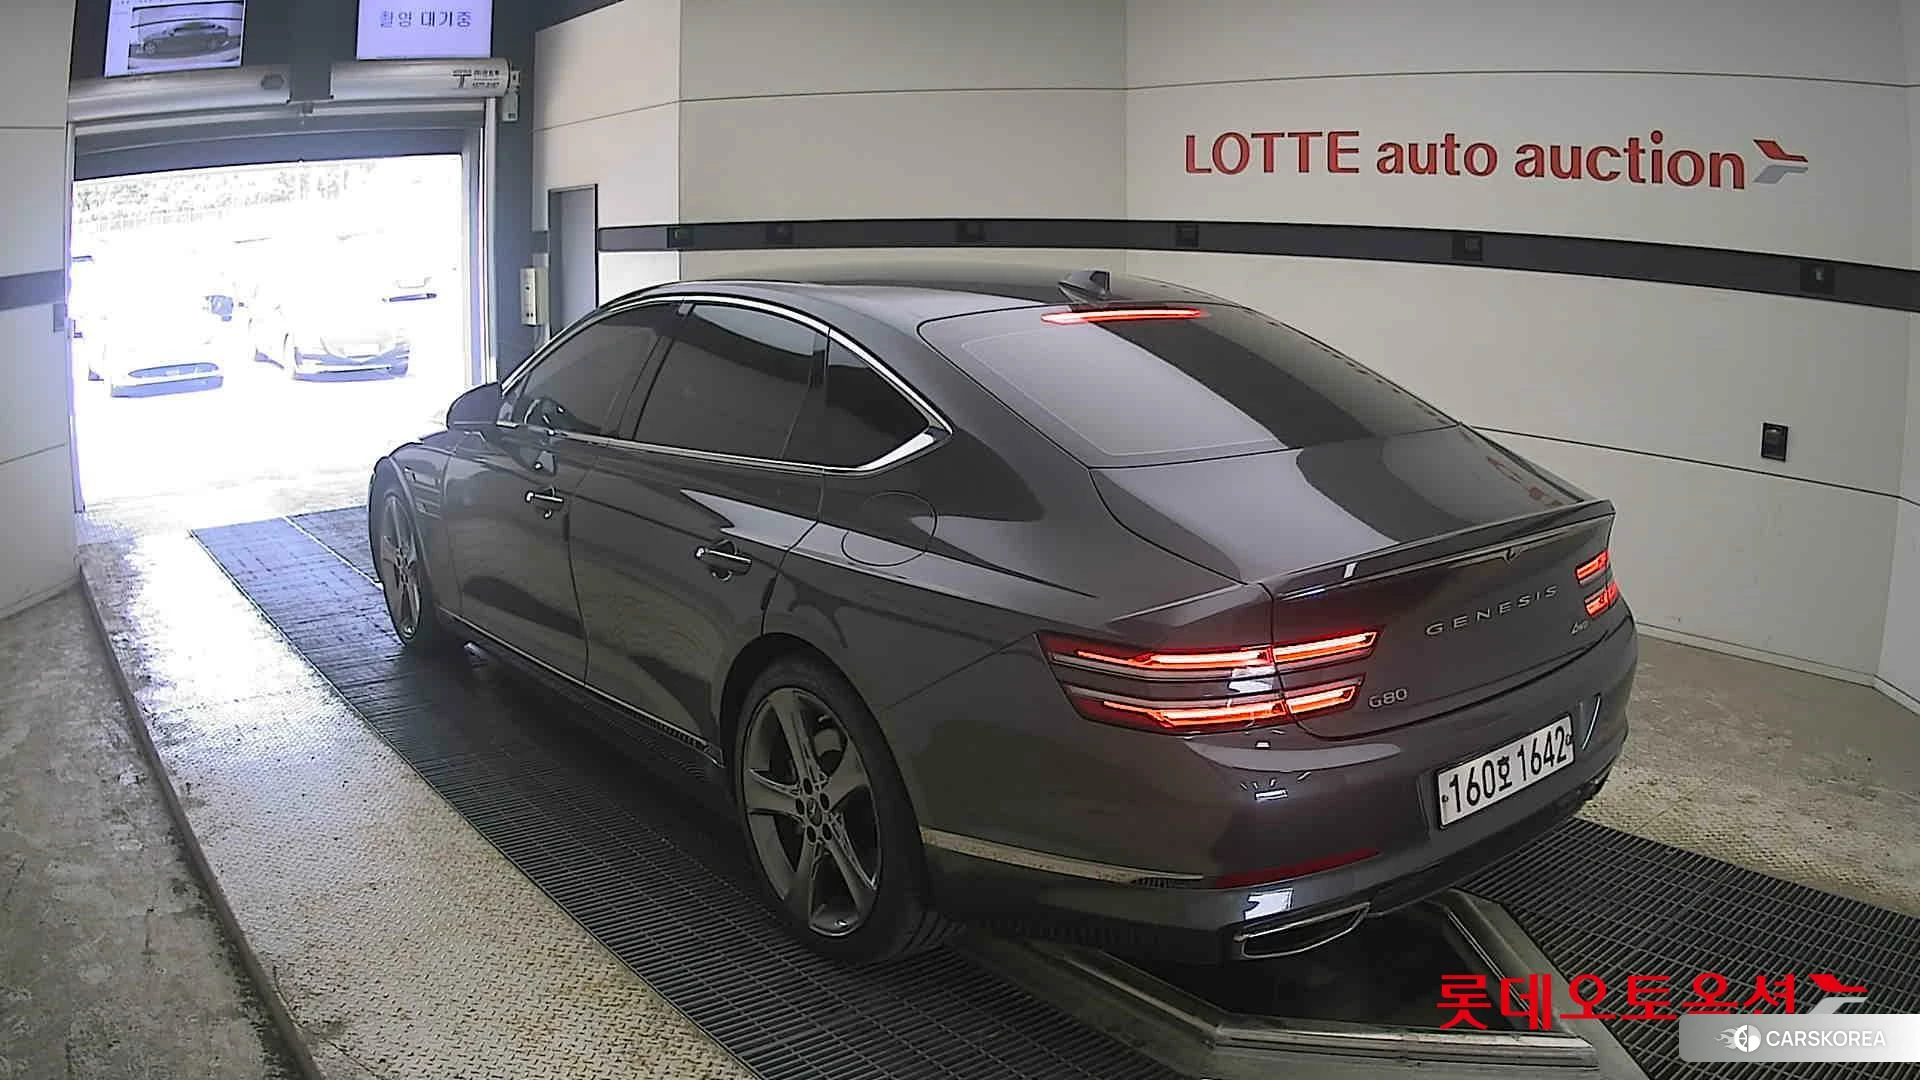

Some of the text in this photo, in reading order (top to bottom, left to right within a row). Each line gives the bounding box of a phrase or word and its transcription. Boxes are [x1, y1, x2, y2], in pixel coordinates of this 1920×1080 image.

[1185, 131, 1746, 189] LOTTE auto auction
[1425, 584, 1559, 636] GENESIS
[1368, 687, 1409, 709] G80
[1448, 724, 1568, 814] 160호 1642
